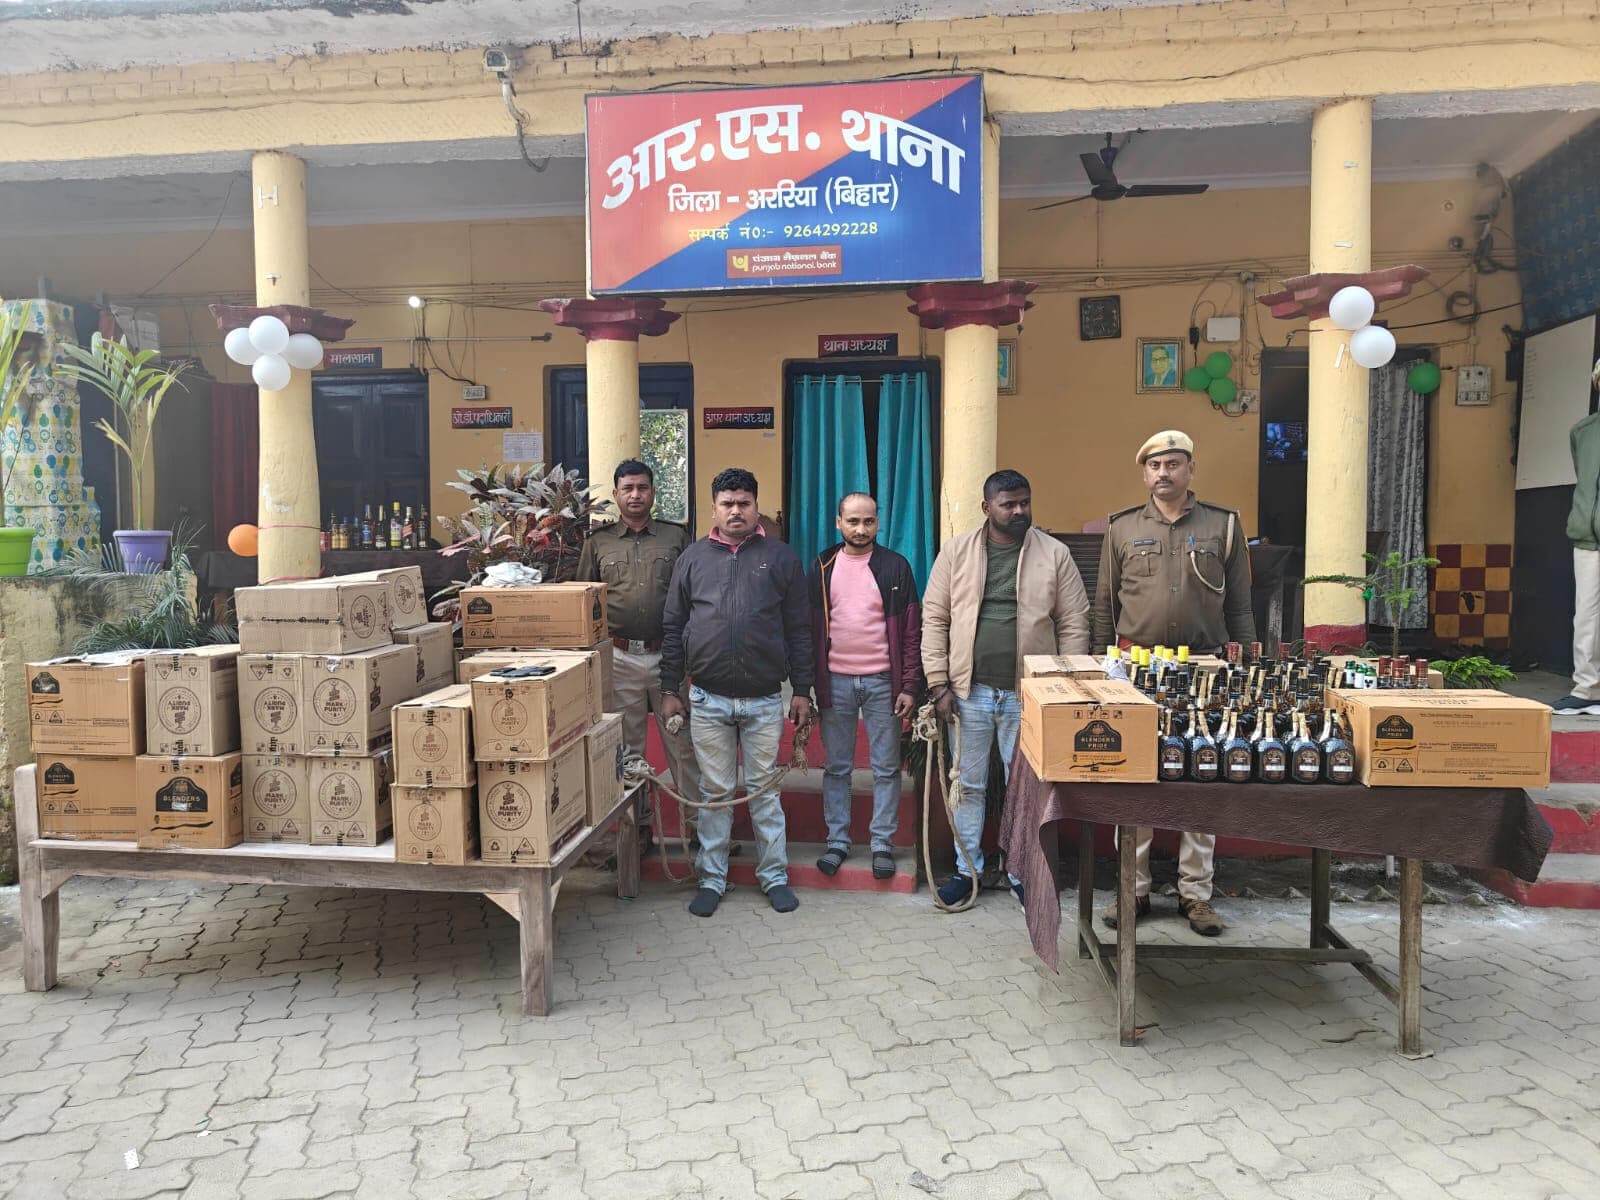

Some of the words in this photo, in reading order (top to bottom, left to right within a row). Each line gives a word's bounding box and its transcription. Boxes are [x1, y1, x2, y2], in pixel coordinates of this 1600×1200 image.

[840, 108, 966, 195] थाना
[667, 187, 721, 213] जिला
[745, 179, 818, 211] अररिया
[825, 174, 900, 215] (बिहार)
[688, 222, 729, 241] सम्पर्क
[783, 221, 878, 238] 9264292228
[752, 262, 780, 273] punjab
[816, 259, 837, 269] bank
[823, 339, 848, 352] थाना
[330, 352, 375, 364] मालखाना
